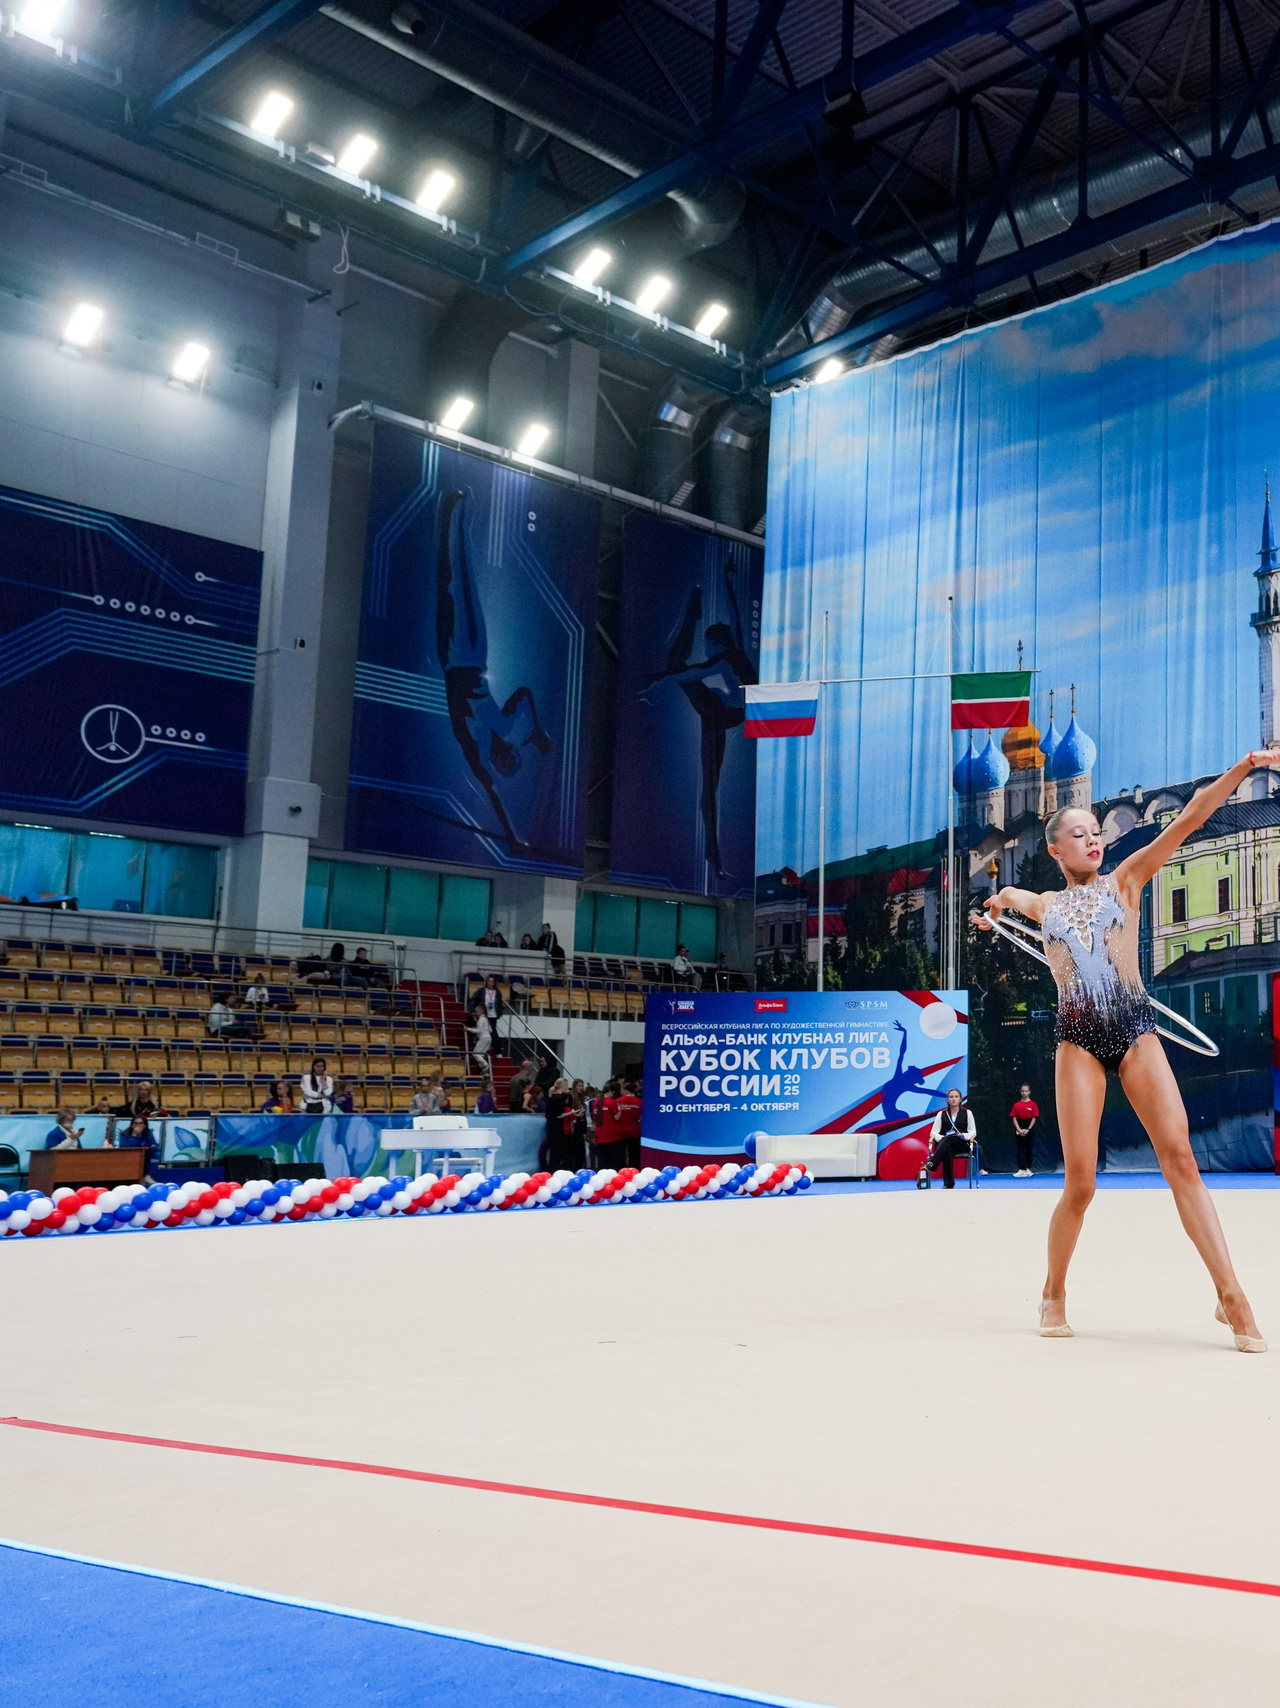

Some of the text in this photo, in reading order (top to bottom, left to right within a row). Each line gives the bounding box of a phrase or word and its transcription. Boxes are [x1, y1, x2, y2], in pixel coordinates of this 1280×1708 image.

[781, 1021, 845, 1029] ХУДОЖЕСТВЕННОЙ
[661, 1031, 889, 1046] АЛЬФА-БАНК КЛУБНАЯ ЛИГА
[660, 1047, 891, 1072] КУБОК КЛУБОВ
[783, 1074, 800, 1084] 20
[659, 1074, 781, 1098] РОССИИ
[783, 1085, 800, 1096] 25
[659, 1104, 673, 1113] 30
[675, 1103, 731, 1112] СЕНТЯБРЯ
[740, 1103, 748, 1111] 4
[750, 1102, 799, 1111] ОКТЯБРЯ
